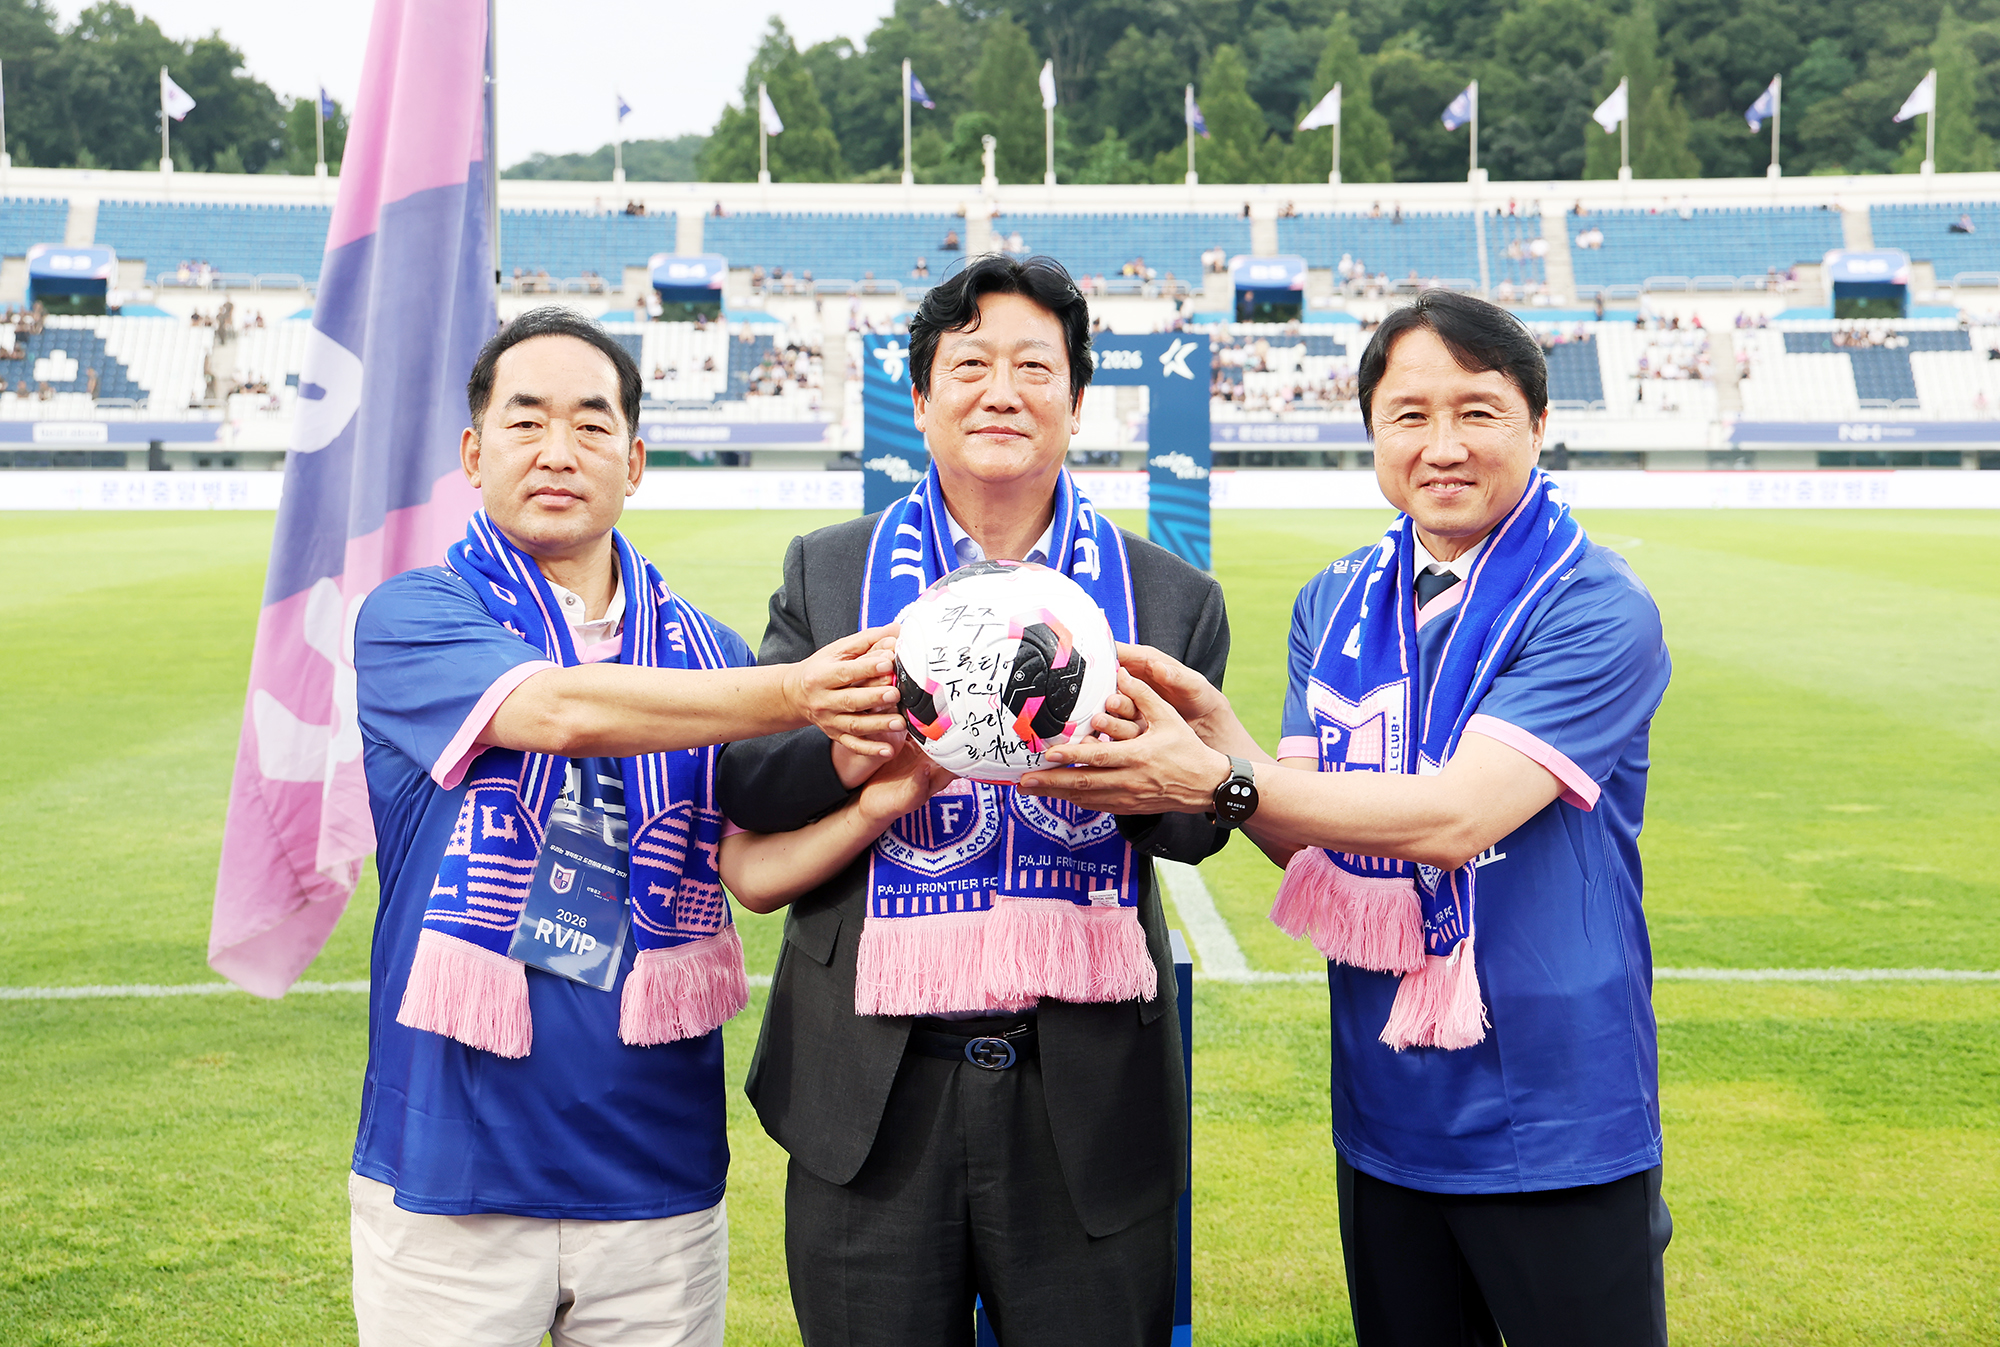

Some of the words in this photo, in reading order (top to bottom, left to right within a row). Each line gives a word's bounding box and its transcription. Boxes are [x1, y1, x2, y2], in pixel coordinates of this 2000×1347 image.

[1101, 350, 1143, 369] 2026
[1320, 724, 1341, 757] P
[1390, 724, 1400, 759] CLUB
[938, 800, 963, 834] F
[1018, 855, 1051, 867] PAJU
[1100, 864, 1117, 875] FC
[877, 884, 911, 896] PAJU
[916, 879, 979, 894] FRONTIER
[555, 908, 588, 928] 2026
[534, 917, 597, 956] RVIP
